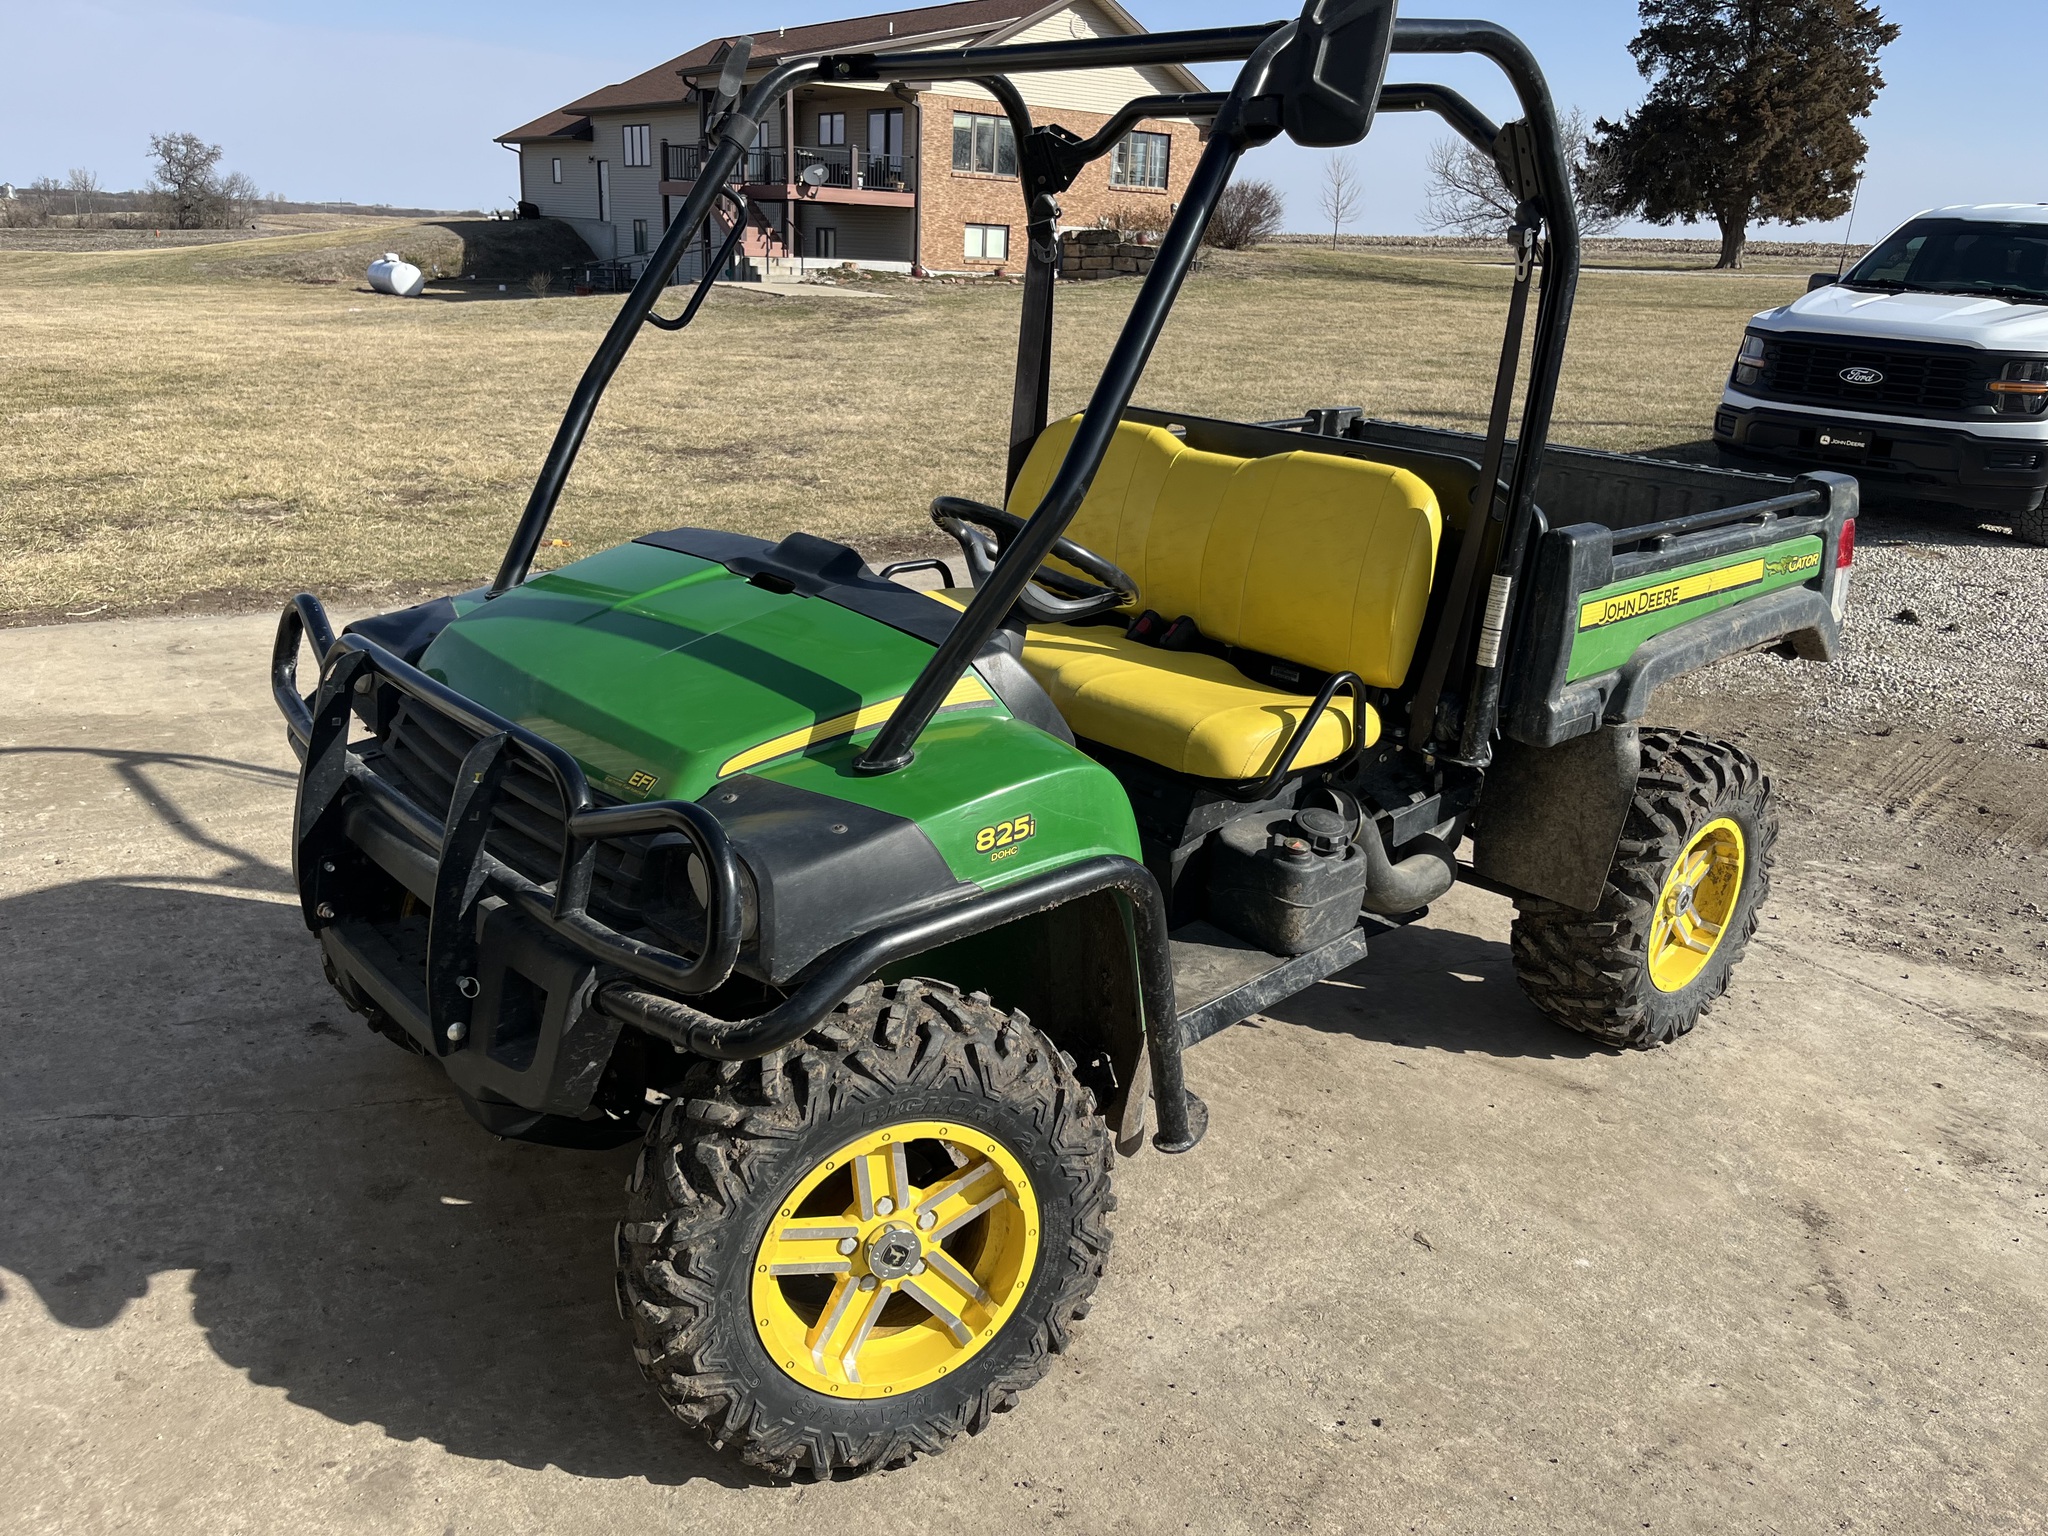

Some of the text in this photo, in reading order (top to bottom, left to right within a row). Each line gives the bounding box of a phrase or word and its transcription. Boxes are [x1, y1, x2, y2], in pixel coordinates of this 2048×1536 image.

[1846, 369, 1875, 382] Ford
[1831, 438, 1866, 448] JOHN DEERE
[1788, 553, 1820, 573] GATOR
[1598, 586, 1680, 622] JOHN DEERE
[628, 770, 657, 791] EFI
[975, 813, 1036, 854] 825i
[990, 846, 1018, 862] DOHC
